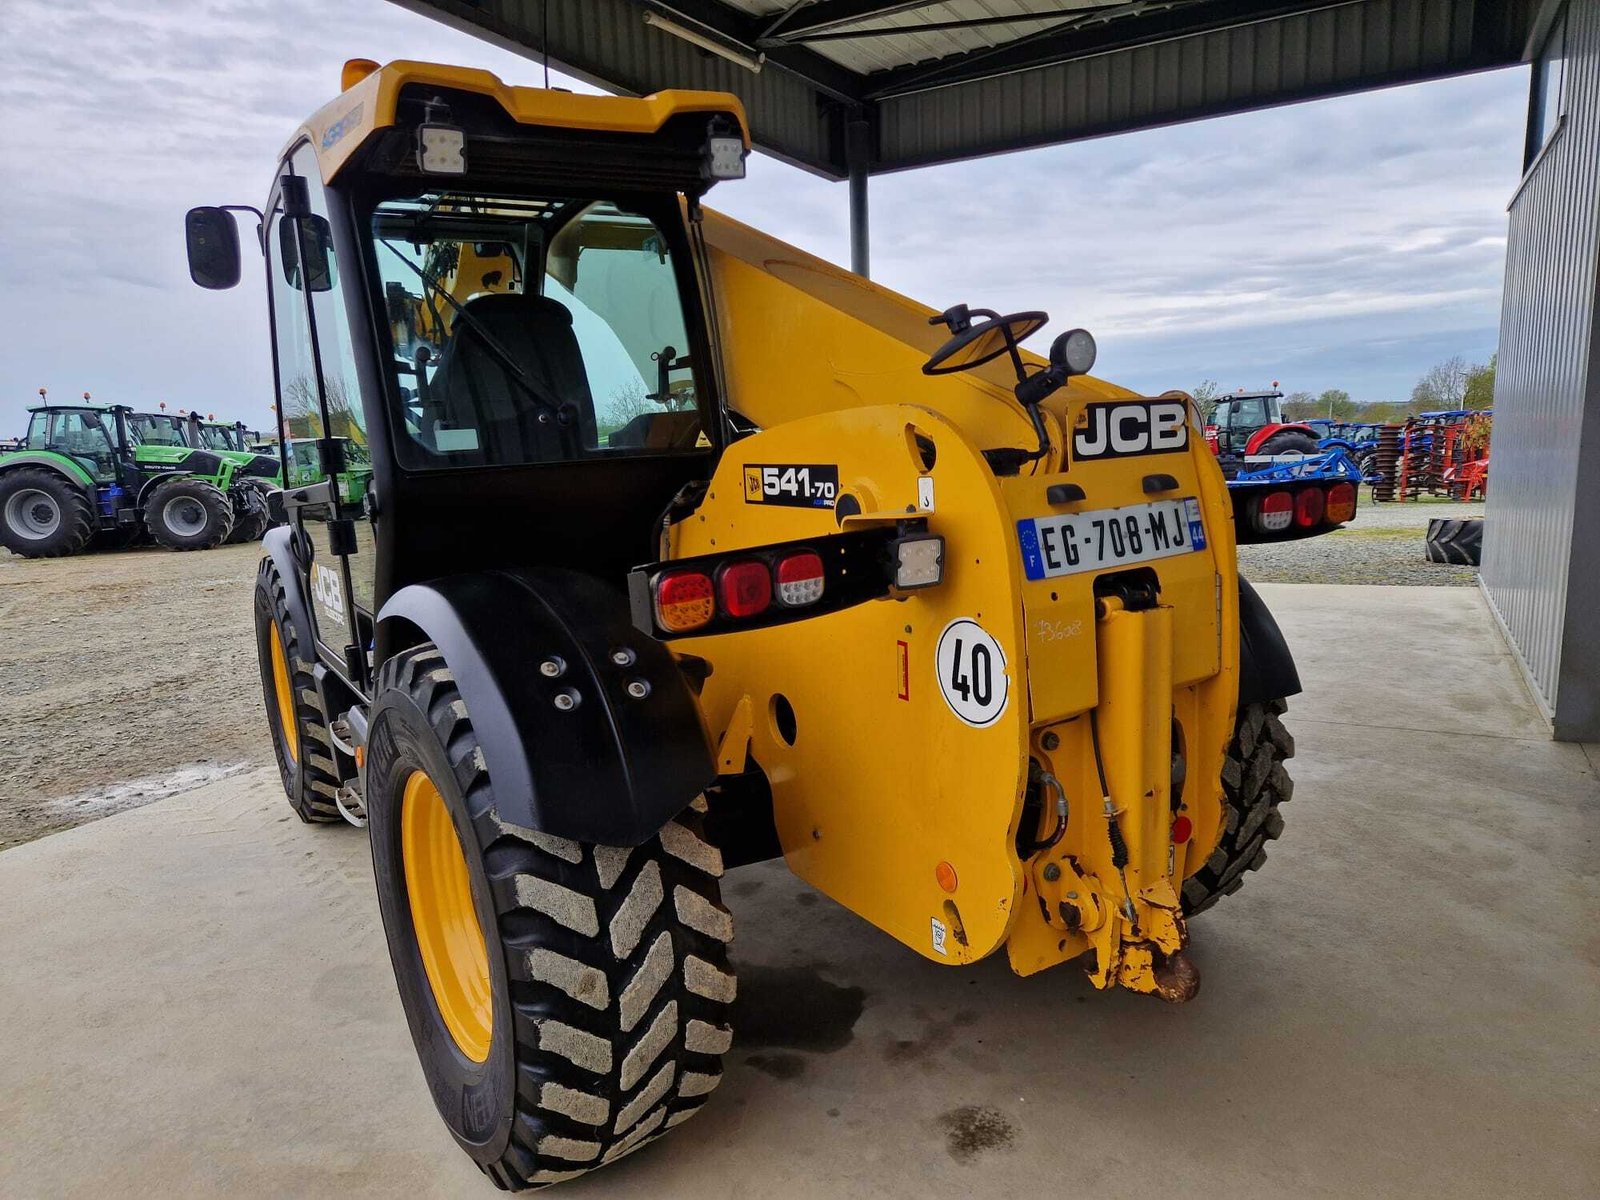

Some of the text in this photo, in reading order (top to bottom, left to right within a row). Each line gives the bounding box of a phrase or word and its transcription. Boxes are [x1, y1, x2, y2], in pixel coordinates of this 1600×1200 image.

[1075, 403, 1187, 456] JCB
[1041, 508, 1185, 570] EG-708-MJ
[1192, 525, 1205, 543] 44
[1029, 555, 1036, 568] F
[952, 638, 992, 707] 40
